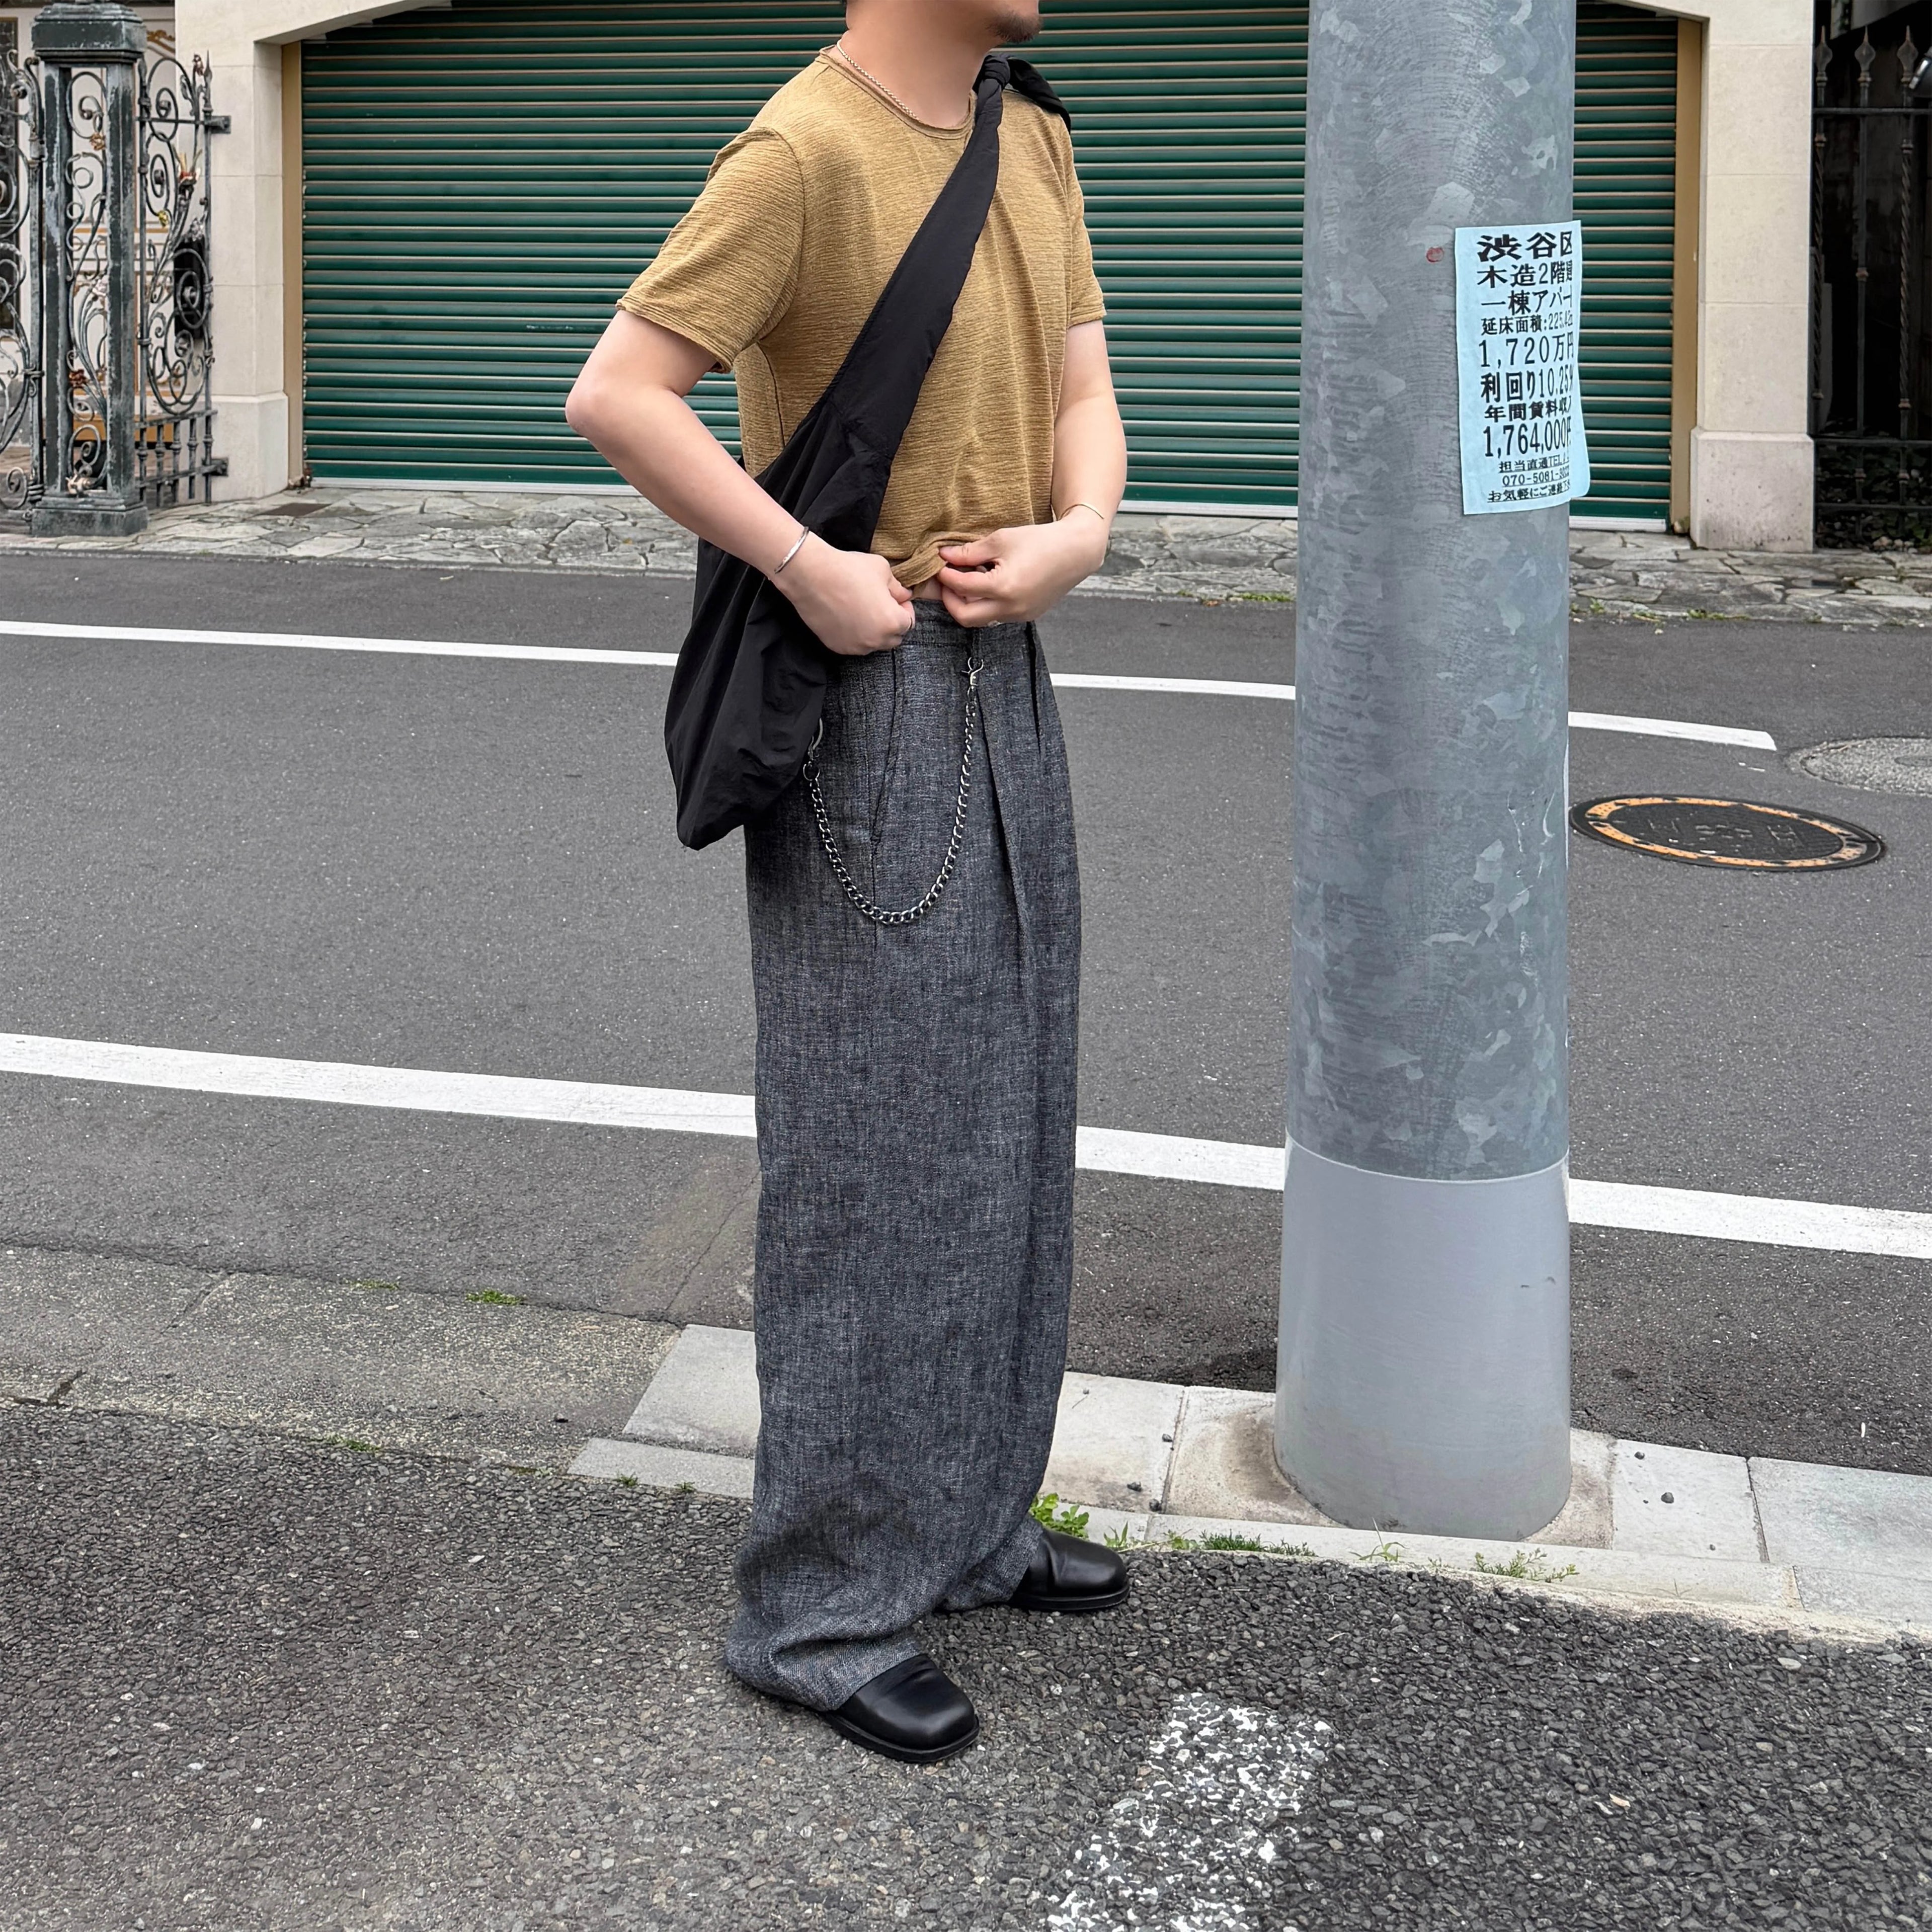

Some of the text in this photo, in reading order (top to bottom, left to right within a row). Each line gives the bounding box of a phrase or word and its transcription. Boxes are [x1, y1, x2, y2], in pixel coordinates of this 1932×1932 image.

[1477, 231, 1572, 262] 渋谷区
[1479, 331, 1573, 368] 1,720万円
[1502, 465, 1569, 486] 070-5081-
